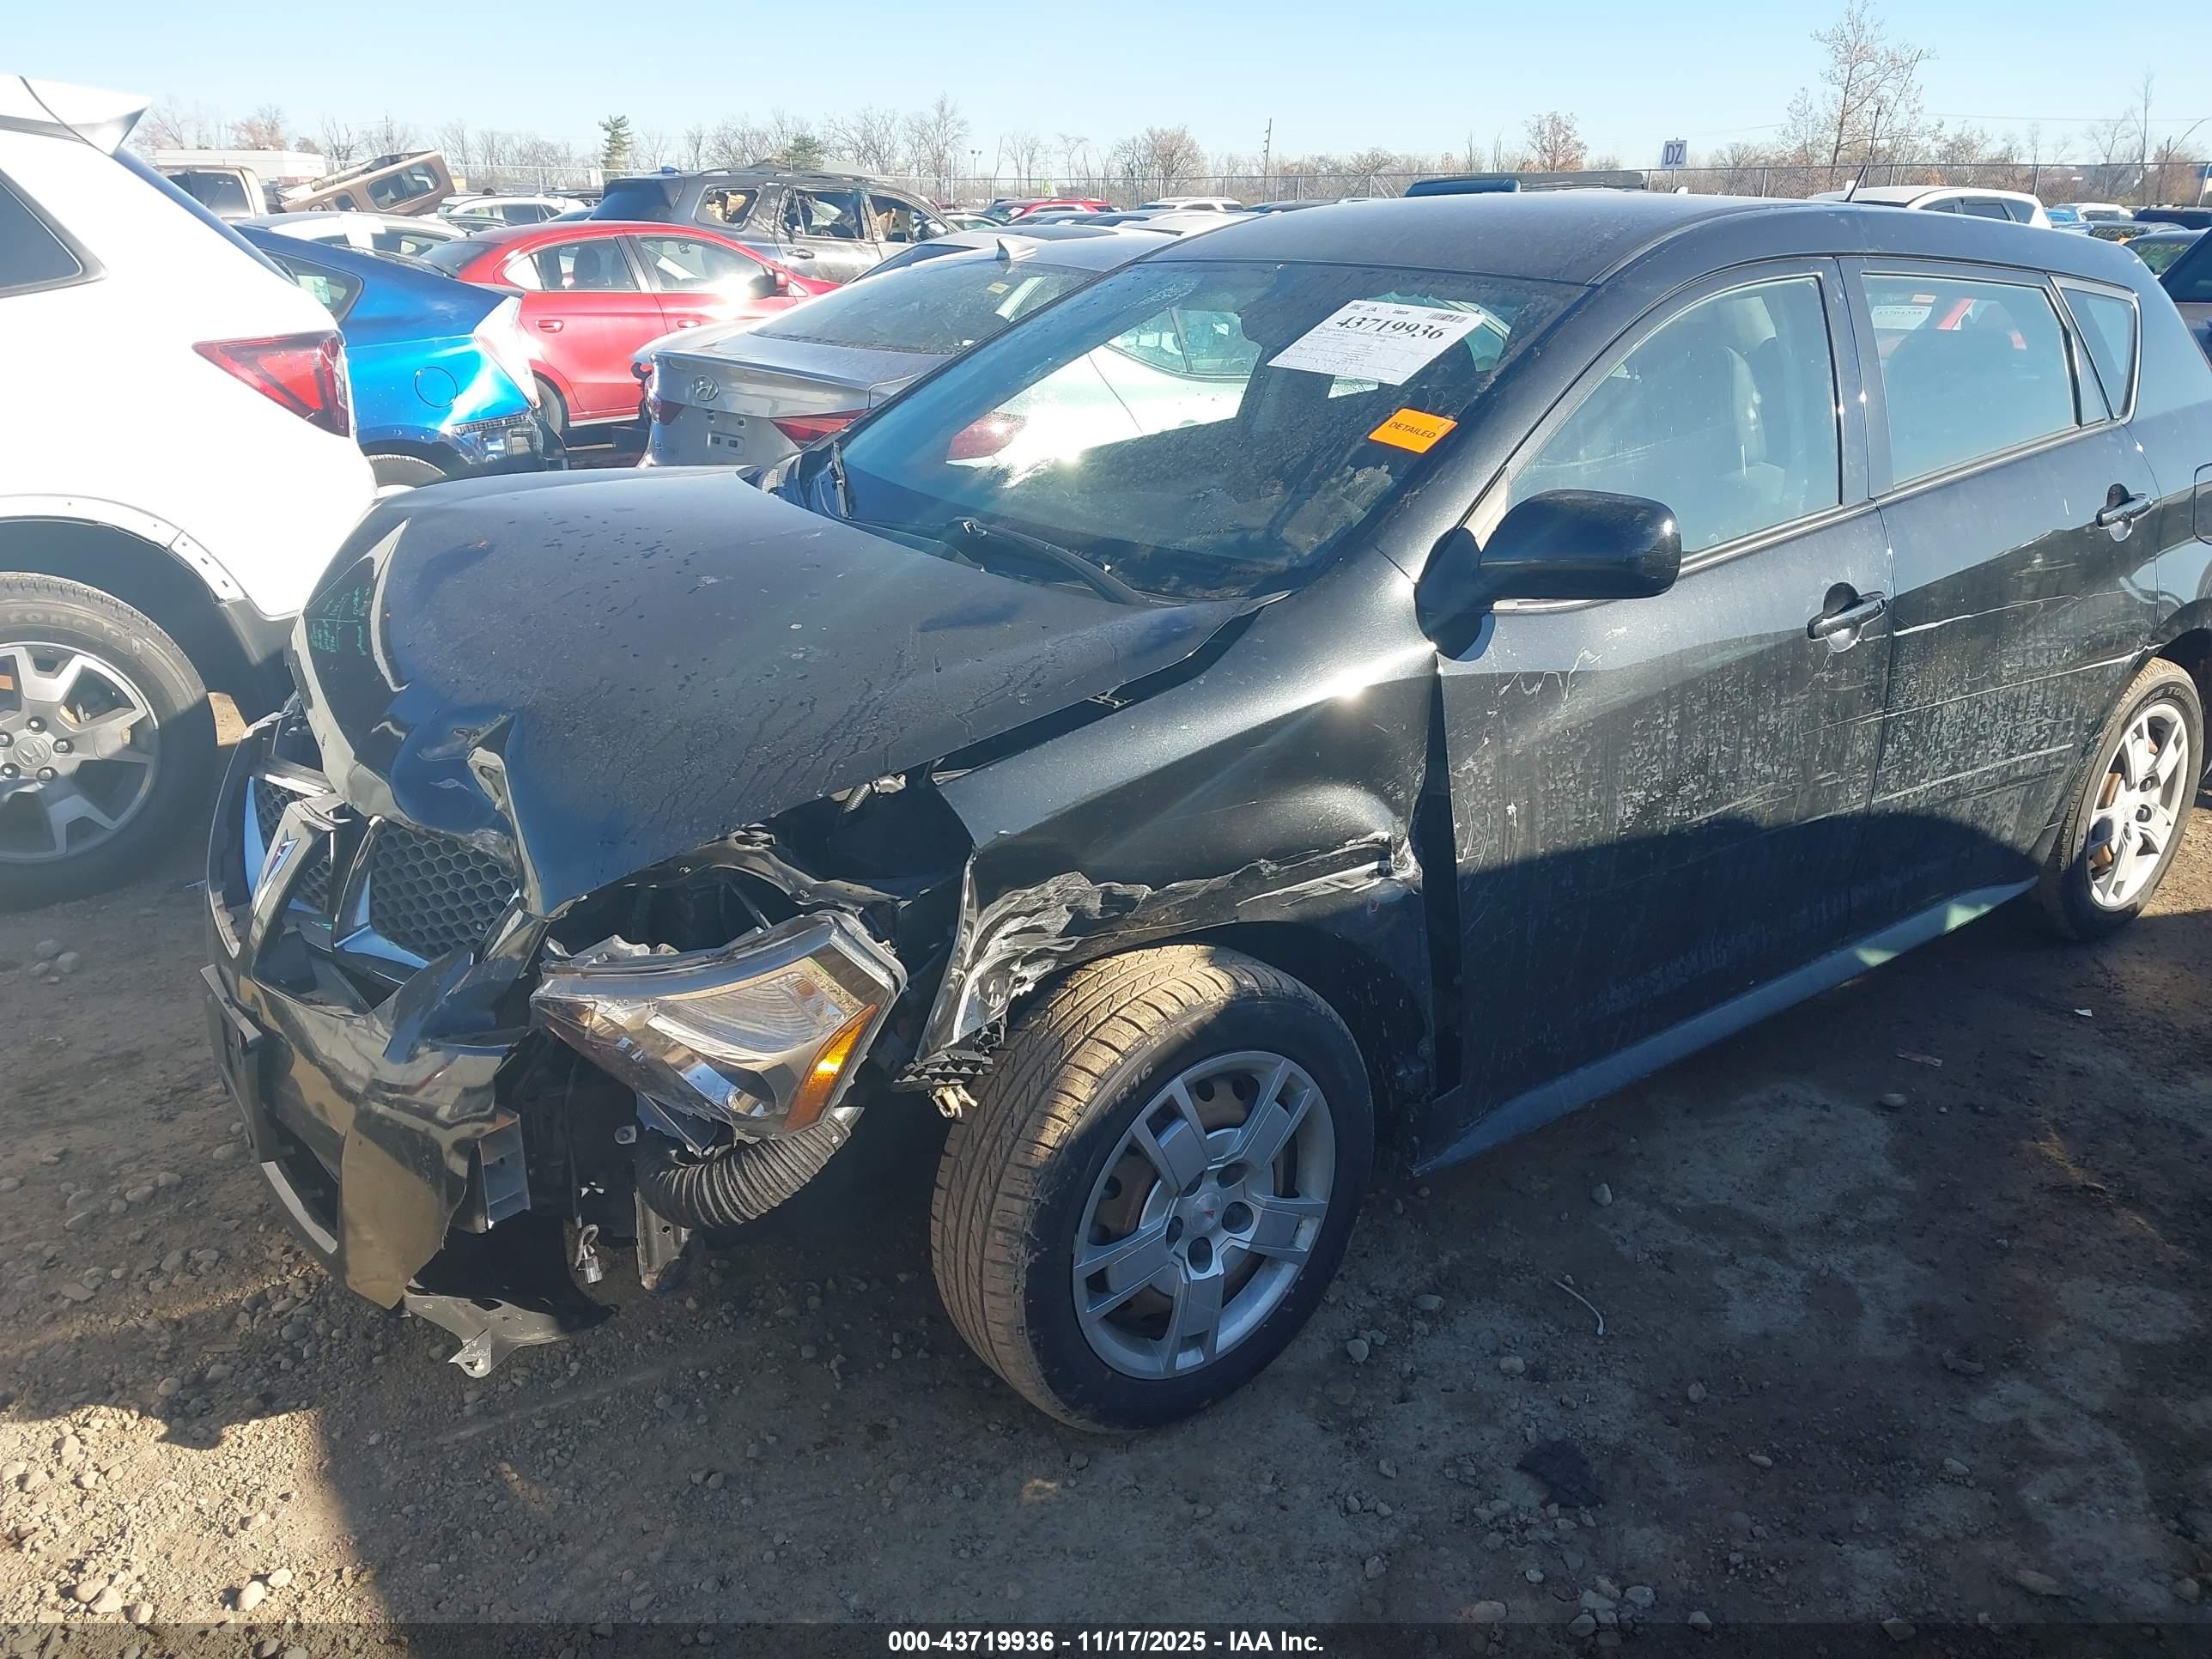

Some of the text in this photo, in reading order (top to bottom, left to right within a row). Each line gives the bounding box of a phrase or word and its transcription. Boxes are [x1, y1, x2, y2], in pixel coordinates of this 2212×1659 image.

[1665, 144, 1683, 165] DZ
[1336, 316, 1451, 340] 43719936
[1389, 421, 1437, 439] DETAILED
